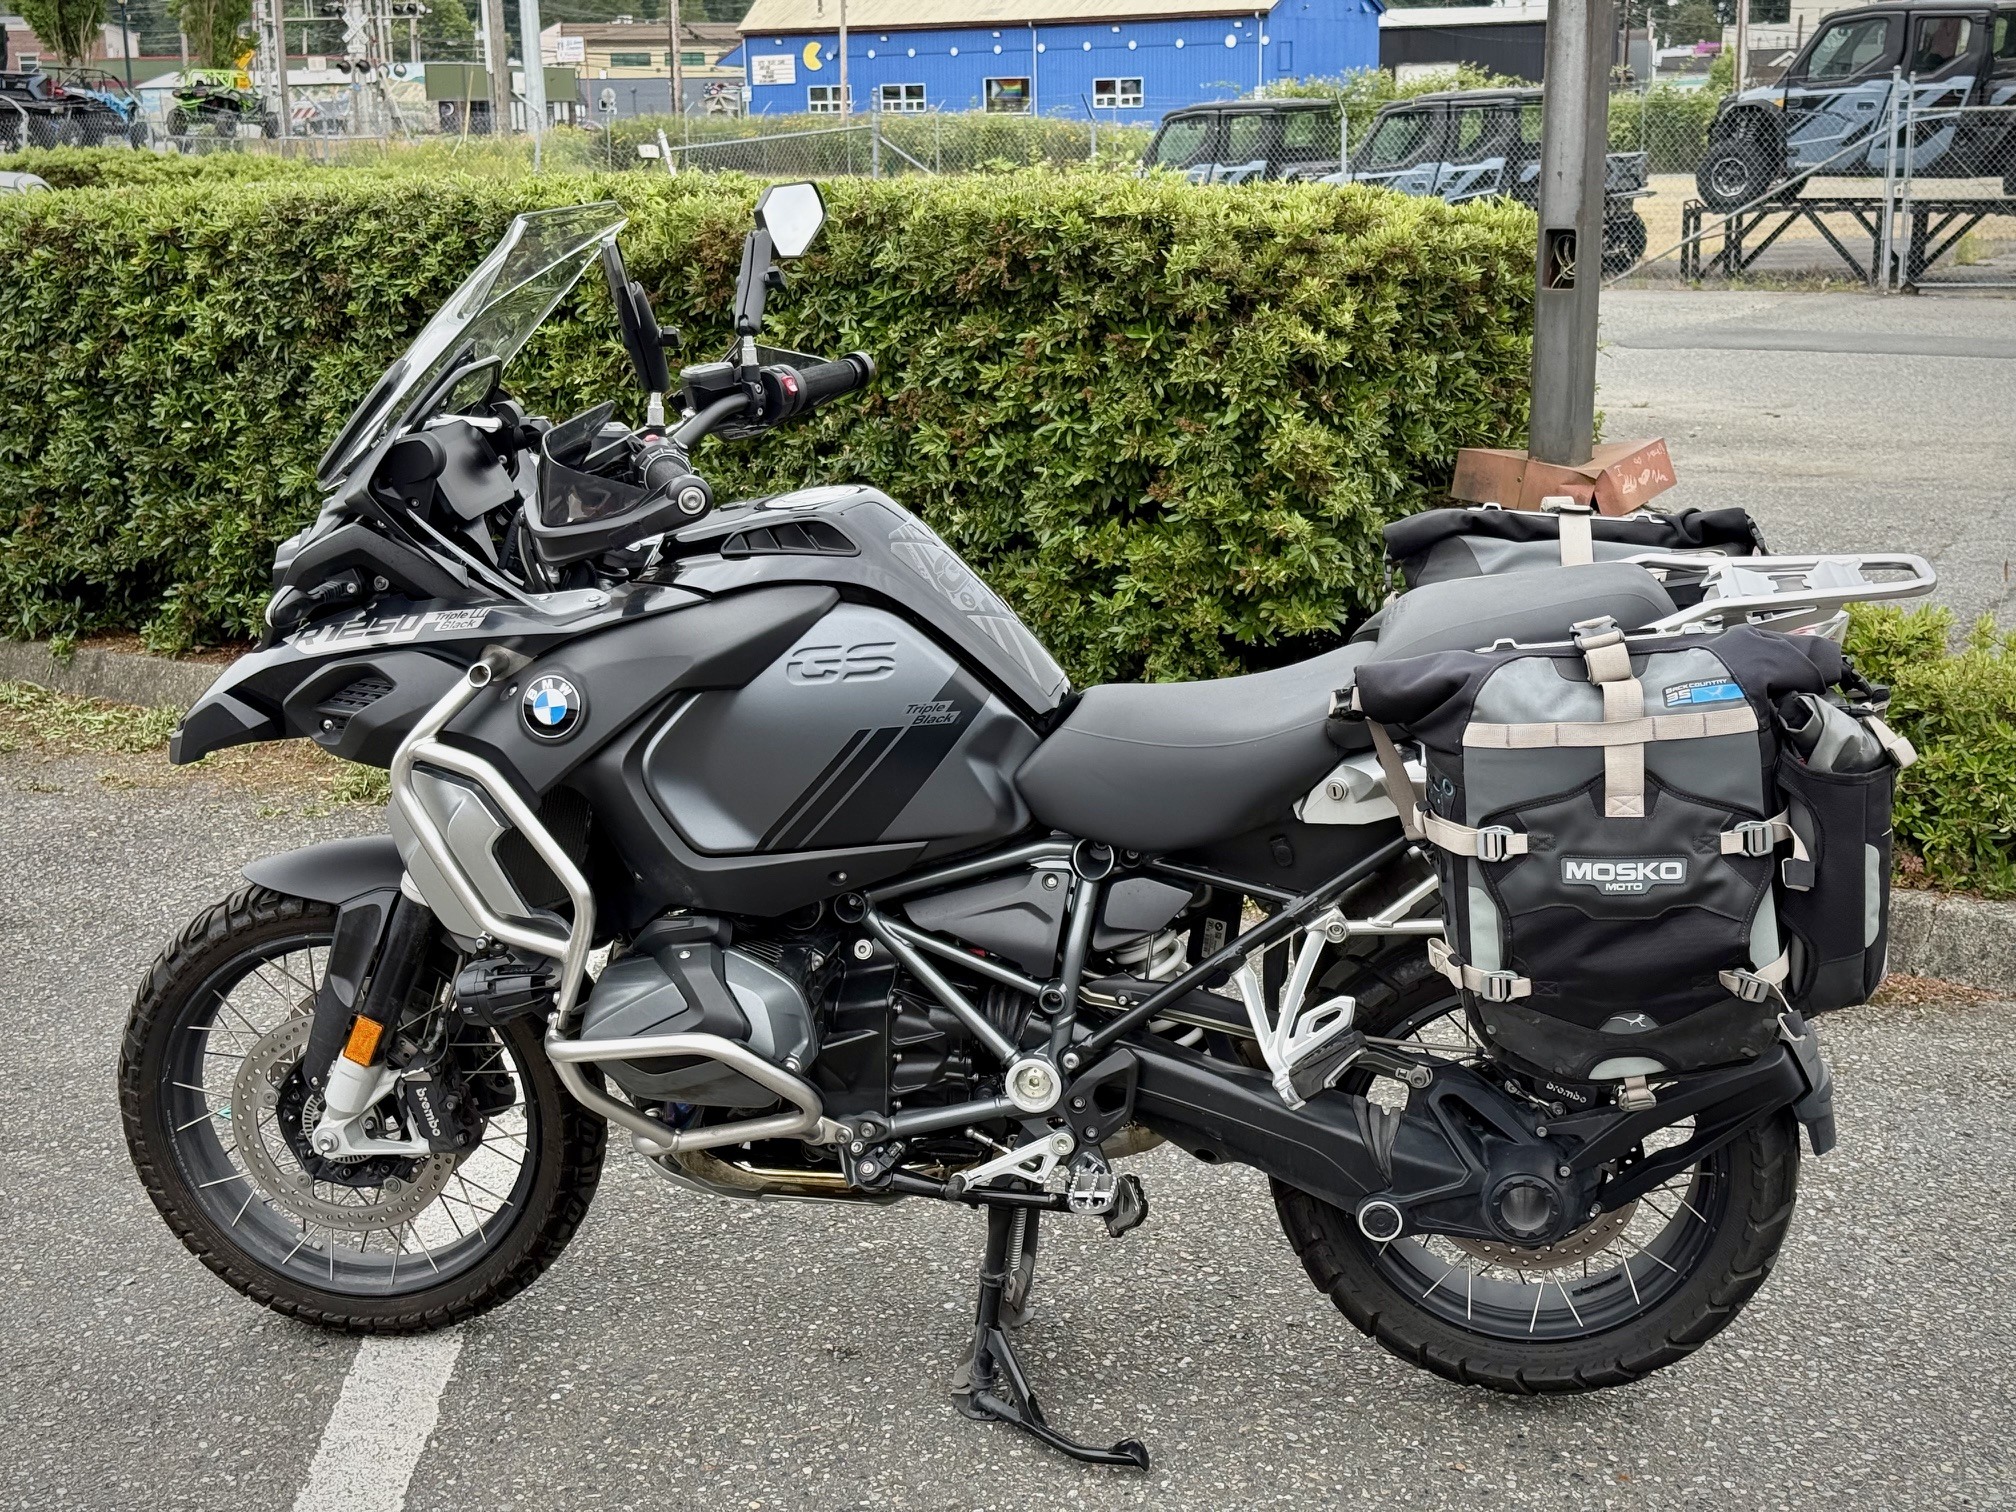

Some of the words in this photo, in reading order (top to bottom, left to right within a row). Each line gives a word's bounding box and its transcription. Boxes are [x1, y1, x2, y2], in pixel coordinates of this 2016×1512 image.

[436, 610, 469, 623] Triple
[440, 620, 475, 630] Black
[786, 641, 896, 686] GS
[526, 678, 573, 701] BMW
[906, 702, 946, 715] Triple
[912, 713, 954, 725] Black
[1566, 862, 1683, 881] MOSKO
[1605, 883, 1643, 891] MOTO
[1545, 1081, 1587, 1104] brembo
[415, 1086, 441, 1137] brembo
